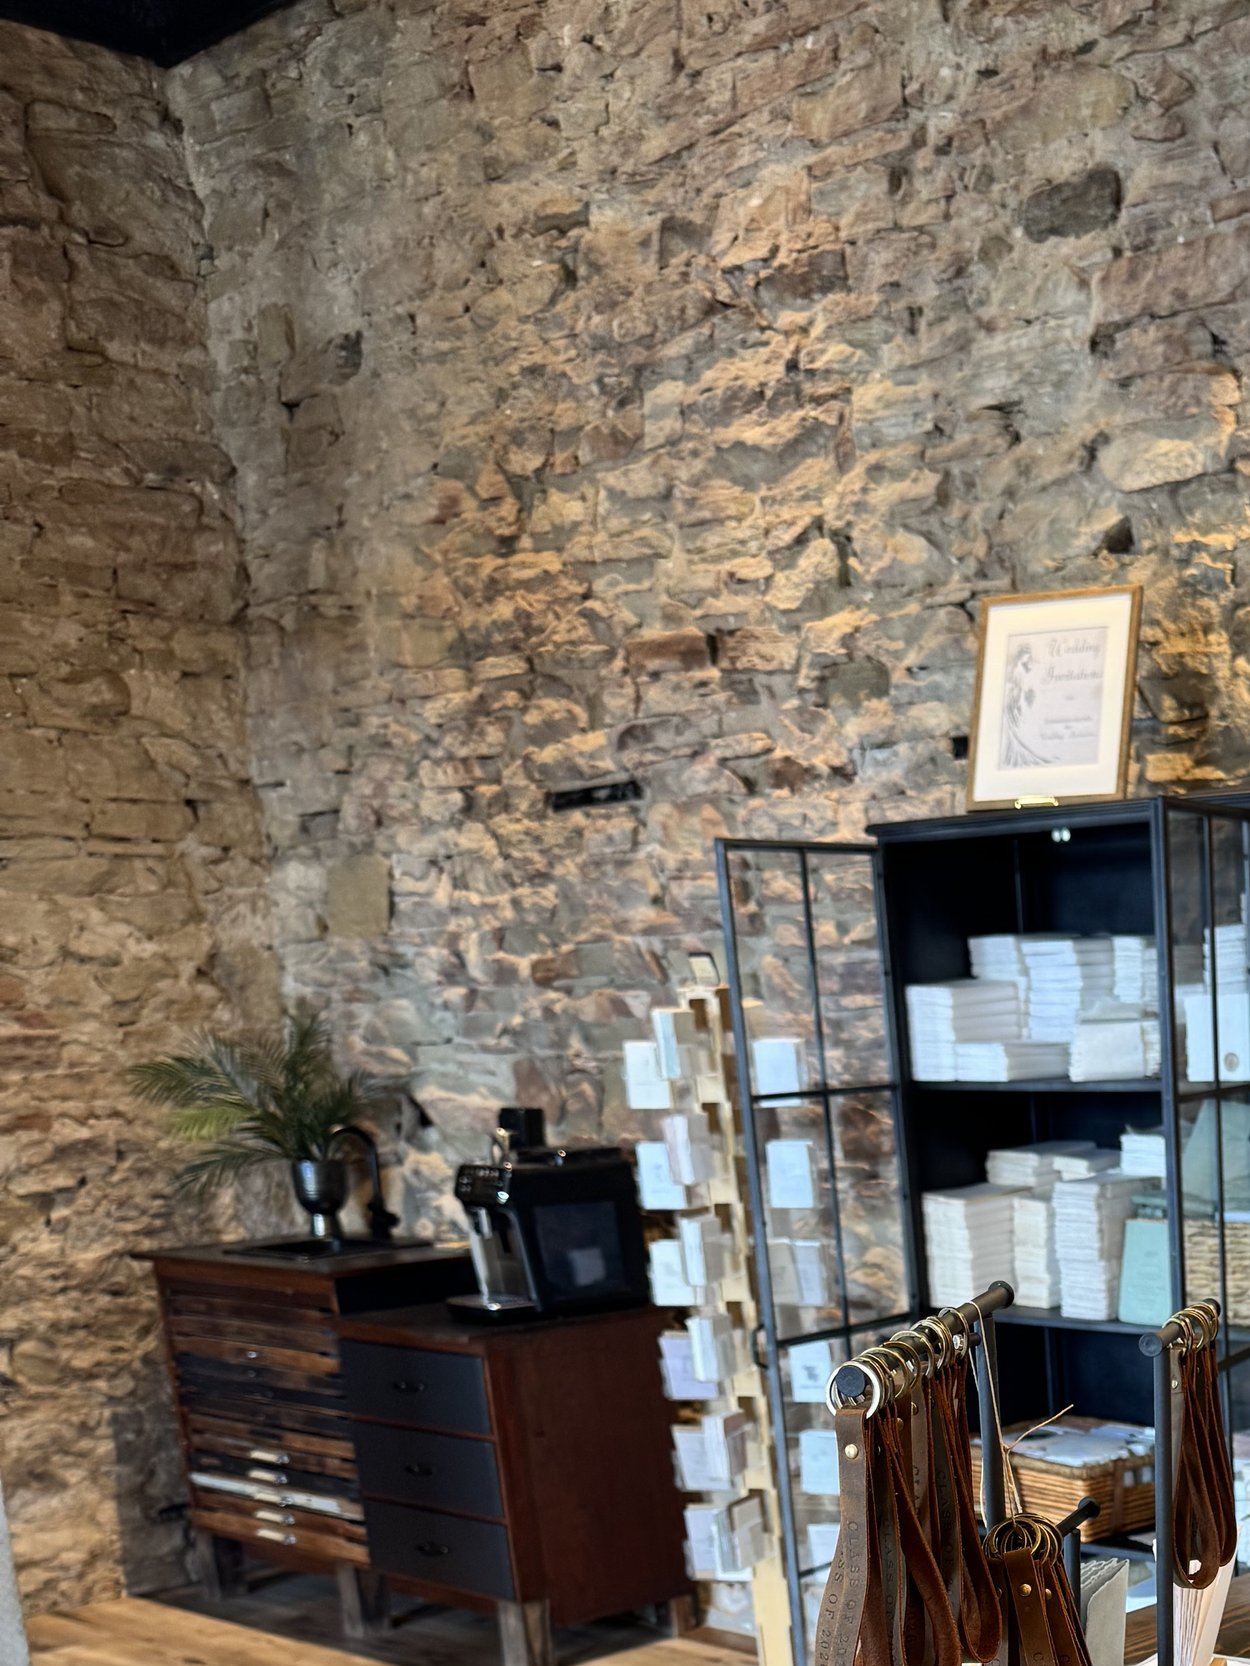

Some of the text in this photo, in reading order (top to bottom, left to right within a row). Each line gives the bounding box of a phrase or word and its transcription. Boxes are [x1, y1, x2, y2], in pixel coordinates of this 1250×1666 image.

[846, 1520, 860, 1588] CLASS
[825, 1593, 839, 1620] OF
[843, 1599, 857, 1625] OF
